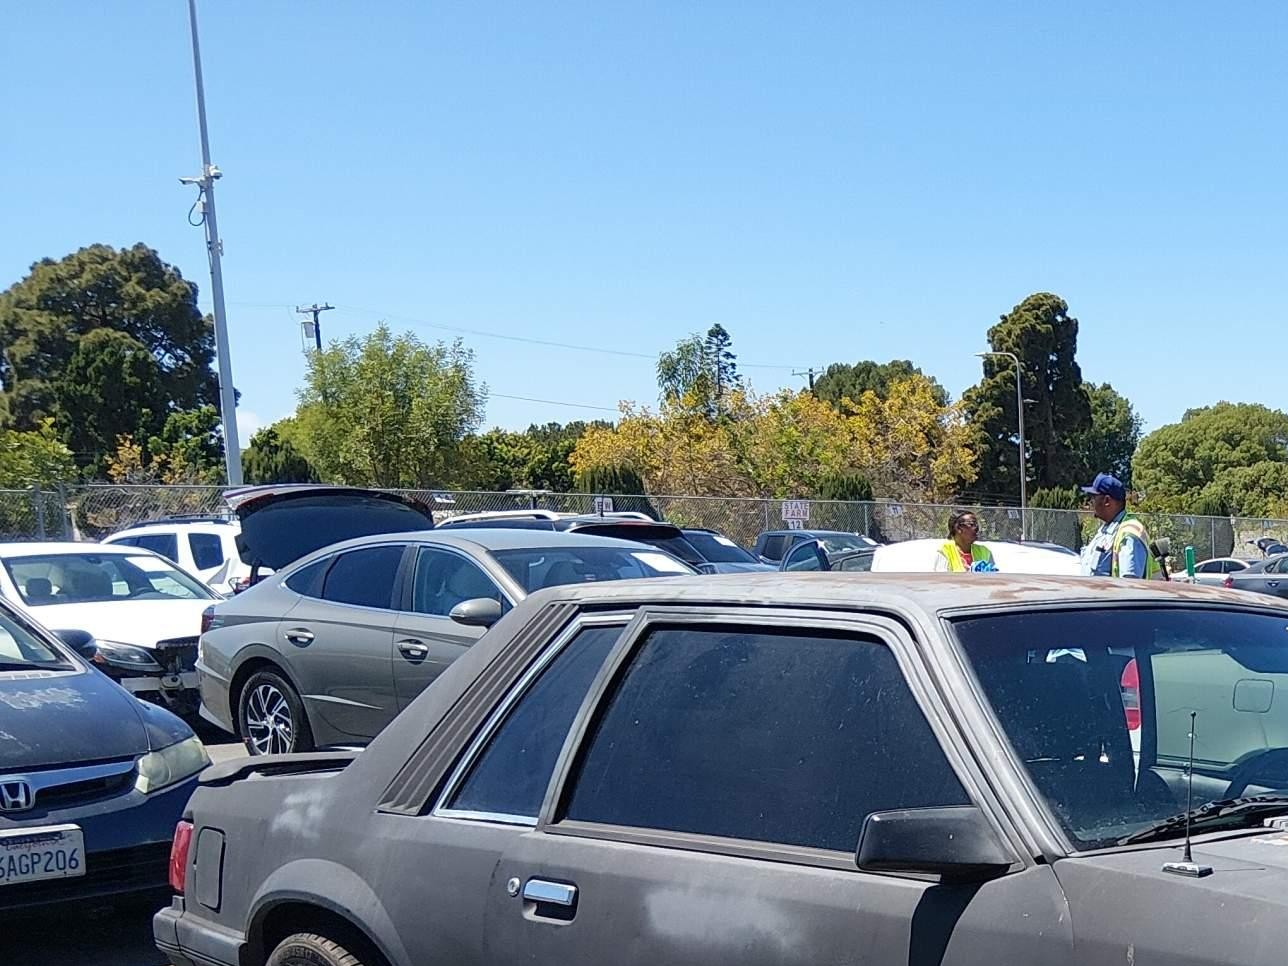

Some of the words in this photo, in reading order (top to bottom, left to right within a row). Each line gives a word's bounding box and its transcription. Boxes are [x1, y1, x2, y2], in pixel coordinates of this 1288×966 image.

[784, 502, 809, 510] STATE
[784, 510, 808, 518] FARM
[790, 520, 802, 529] 12
